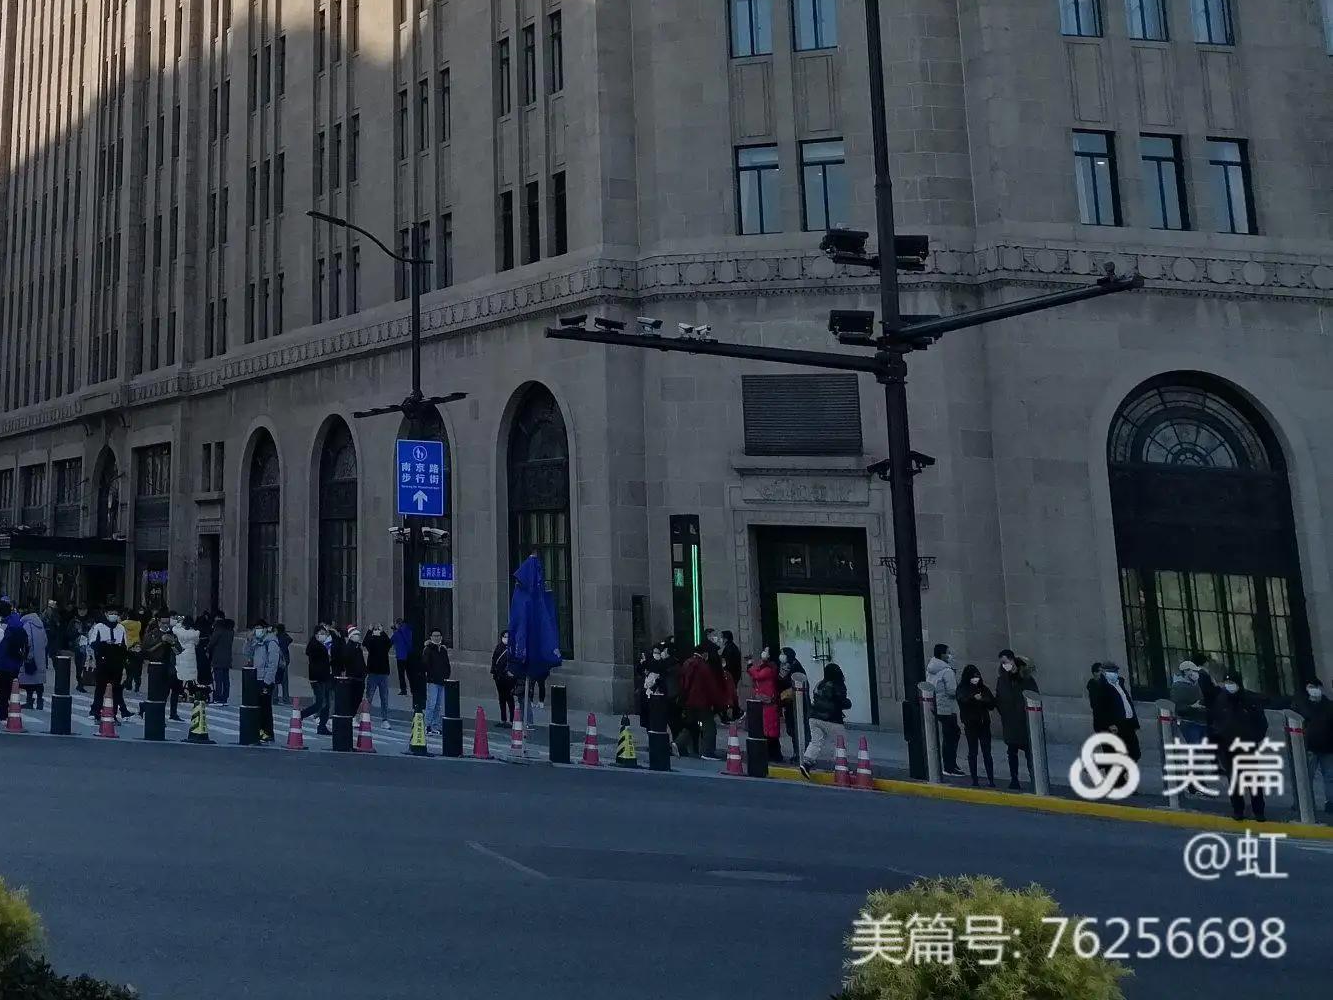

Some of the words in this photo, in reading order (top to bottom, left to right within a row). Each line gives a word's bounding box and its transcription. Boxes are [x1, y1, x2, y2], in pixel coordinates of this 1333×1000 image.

[401, 462, 440, 474] 南京路
[401, 473, 440, 485] 步行街
